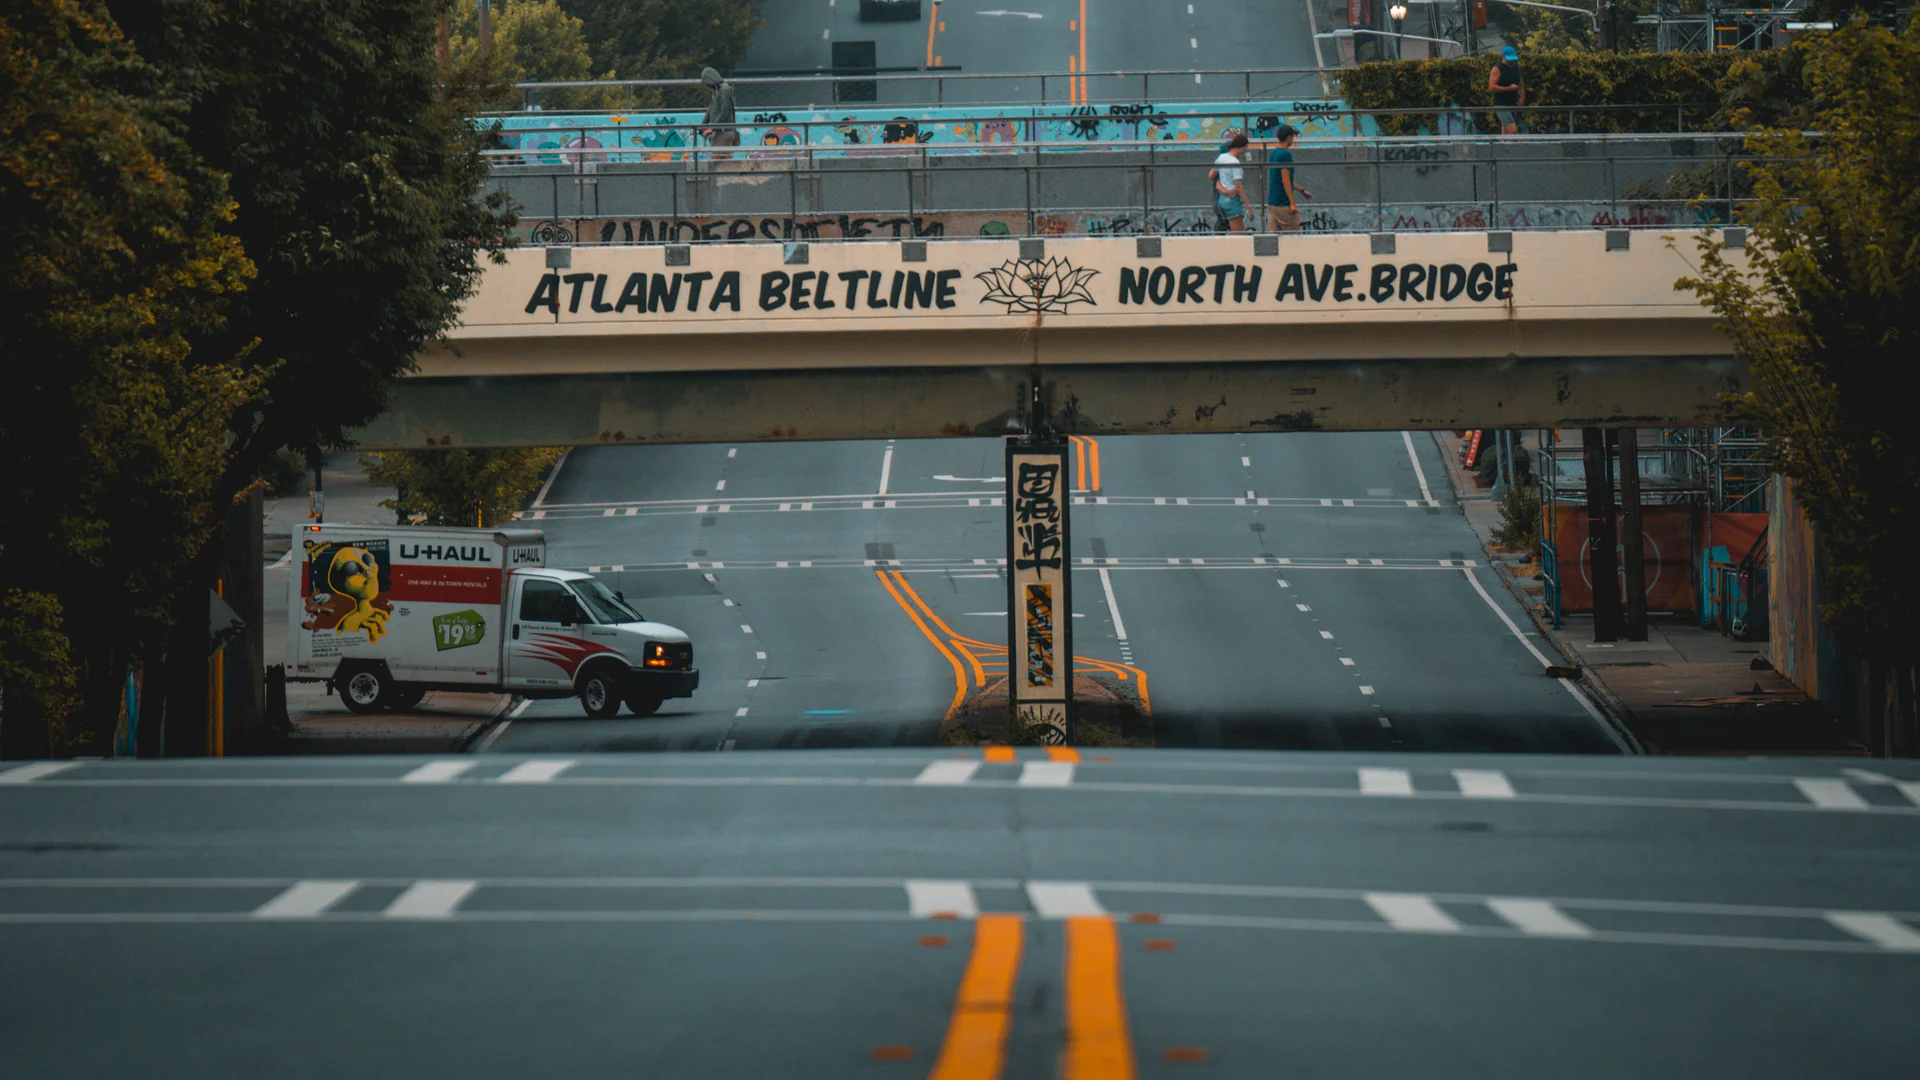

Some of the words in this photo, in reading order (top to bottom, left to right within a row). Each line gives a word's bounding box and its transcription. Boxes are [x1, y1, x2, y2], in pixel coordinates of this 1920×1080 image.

[526, 272, 741, 315] ATLANTA
[758, 269, 962, 312] BELTLINE
[1119, 263, 1263, 306] NORTH
[400, 544, 492, 562] U-HAUL
[513, 548, 541, 563] U-HAUL
